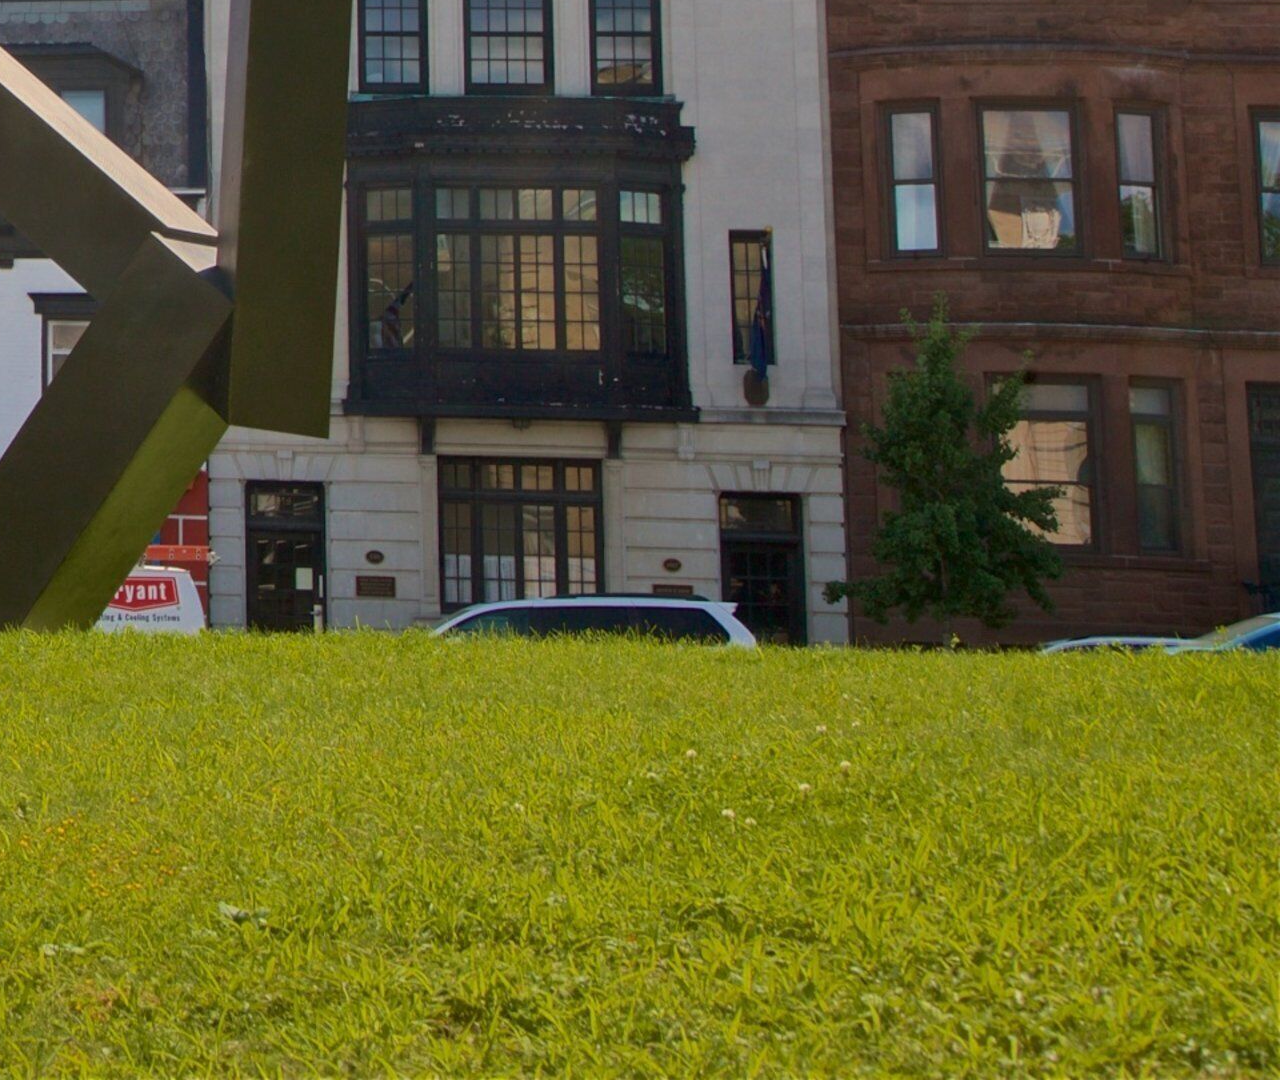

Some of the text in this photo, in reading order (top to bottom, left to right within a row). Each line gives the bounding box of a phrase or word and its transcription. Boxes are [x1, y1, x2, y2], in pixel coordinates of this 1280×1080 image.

[114, 582, 167, 603] ryant
[125, 613, 150, 622] Cooling
[152, 614, 180, 622] Systems
